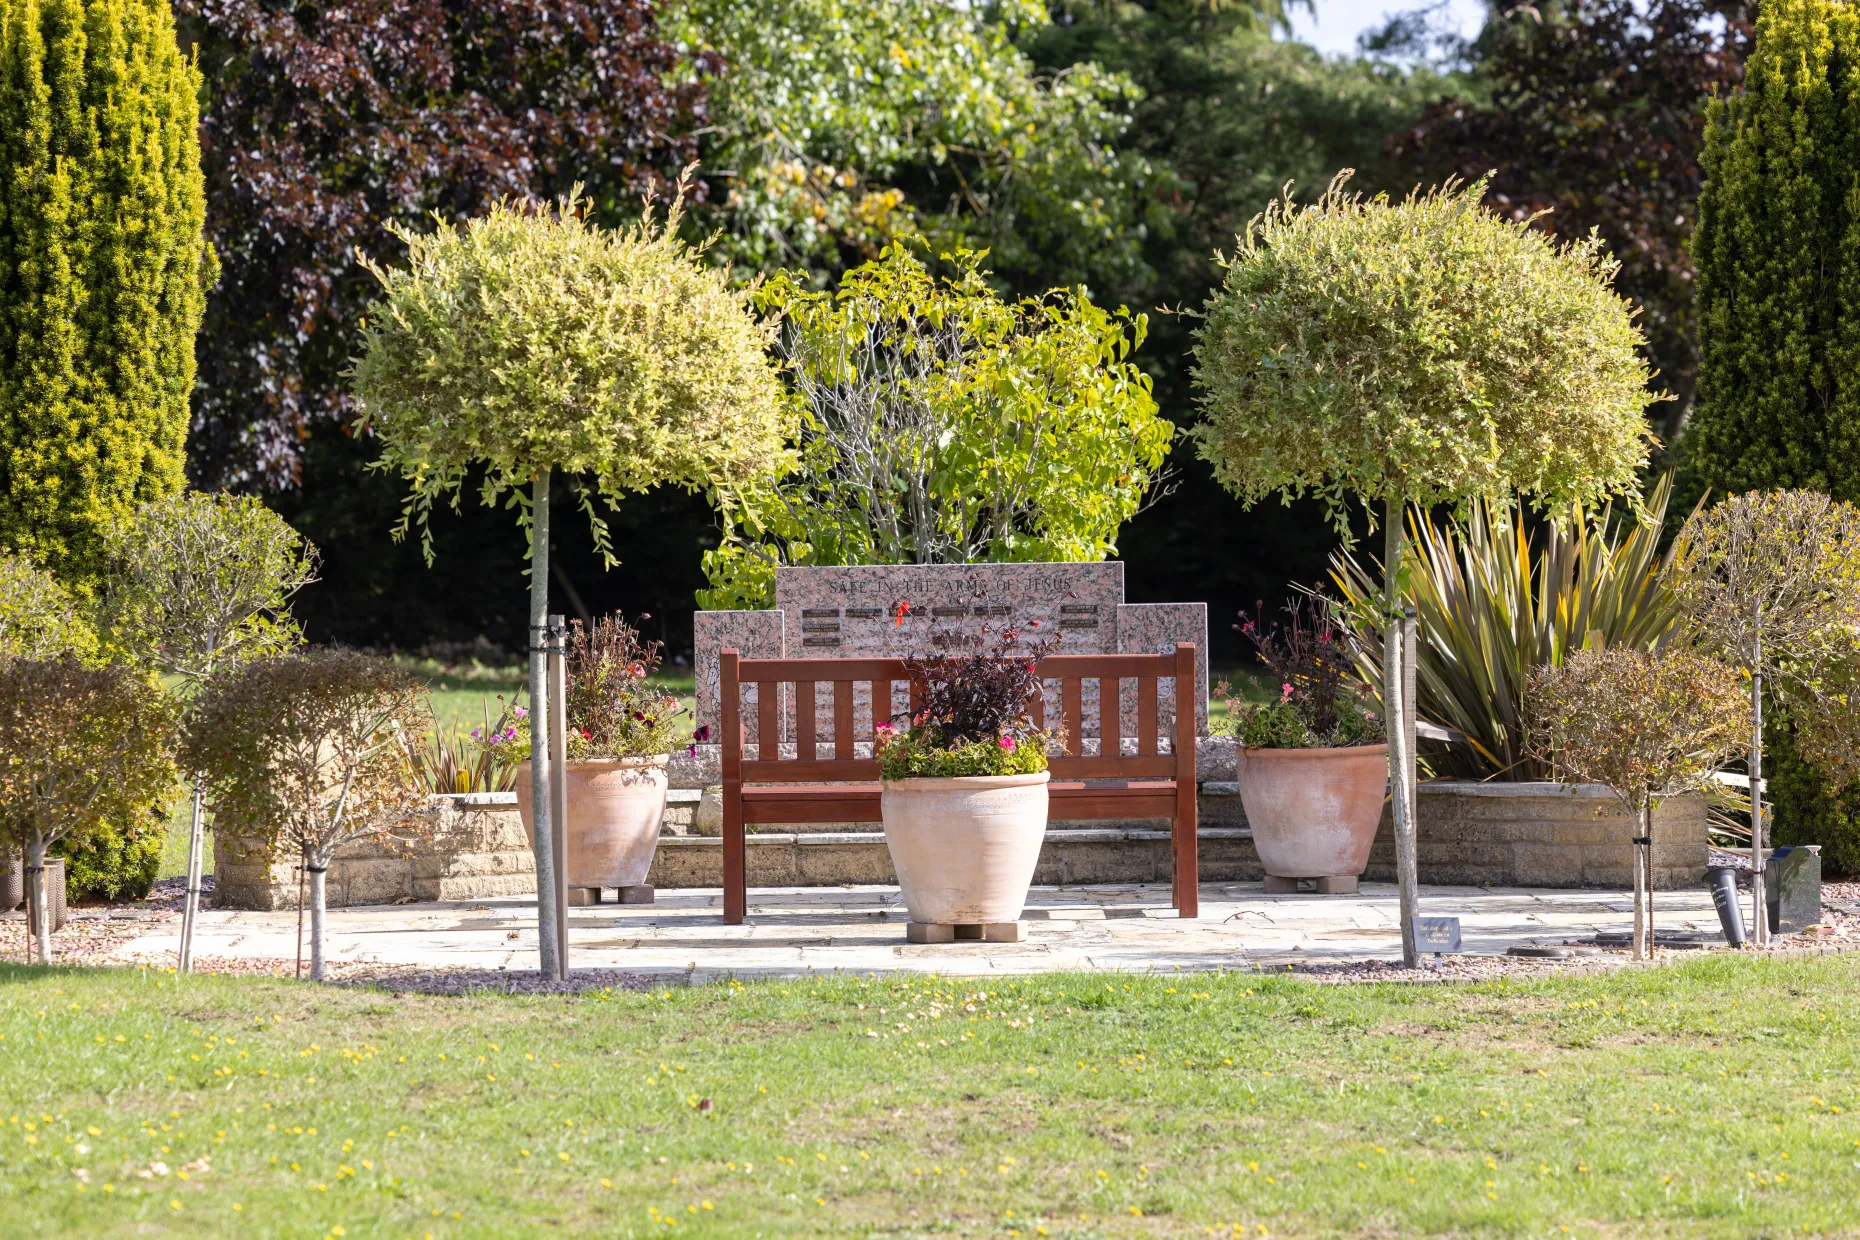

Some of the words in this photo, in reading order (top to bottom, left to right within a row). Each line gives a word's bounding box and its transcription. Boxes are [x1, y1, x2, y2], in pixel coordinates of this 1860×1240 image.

[829, 581, 867, 593] SAFE
[876, 580, 898, 592] IN
[903, 580, 932, 592] THE
[997, 578, 1014, 591] OF
[1024, 578, 1072, 591] JESUS
